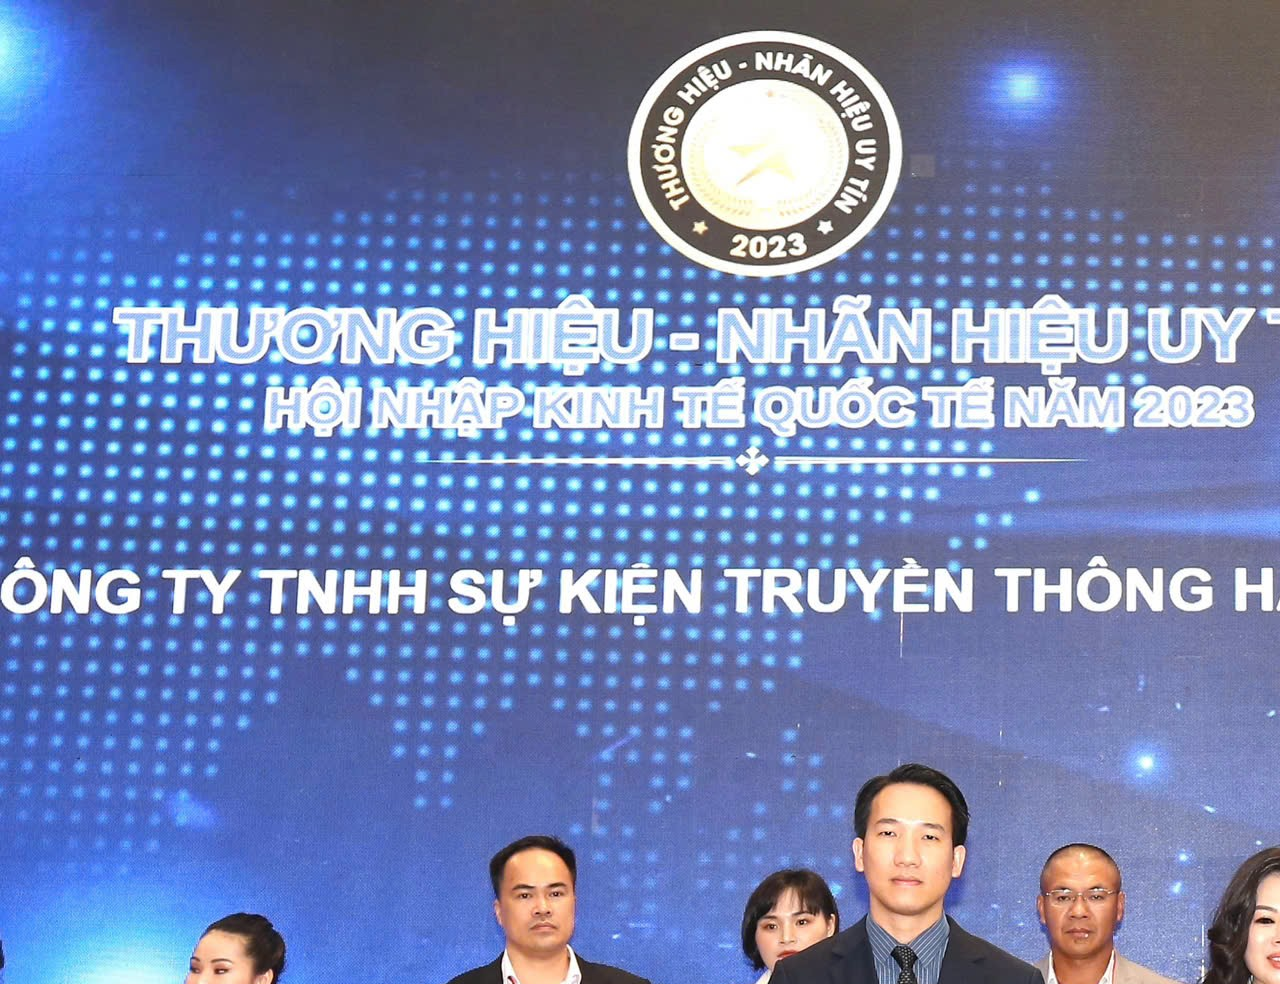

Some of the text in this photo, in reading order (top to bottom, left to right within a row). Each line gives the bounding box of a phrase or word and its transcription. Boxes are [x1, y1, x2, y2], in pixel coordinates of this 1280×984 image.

[676, 60, 733, 105] HIỆU
[755, 52, 834, 87] NHÃN
[829, 80, 874, 132] HIỆU
[652, 106, 690, 211] THƯƠNG
[854, 138, 877, 171] UY
[834, 176, 870, 214] TÍN
[729, 233, 807, 259] 2023
[114, 306, 455, 364] THƯƠNG
[473, 294, 656, 376] HIỆU
[669, 332, 700, 351] -
[715, 294, 933, 364] NHÃN
[951, 294, 1128, 374] HIỆU
[1147, 306, 1256, 363] UY
[264, 376, 1256, 437] HỘI NHẬP KINH TẾ QUỐC TẾ NĂM 2023
[0, 557, 141, 614] ÔNG
[161, 569, 241, 614] TY
[259, 569, 427, 614] TNHH
[447, 568, 542, 626] SỰ
[559, 563, 702, 626] KIỆN
[724, 557, 973, 613] TRUYỀN
[994, 556, 1213, 612] THÔNG
